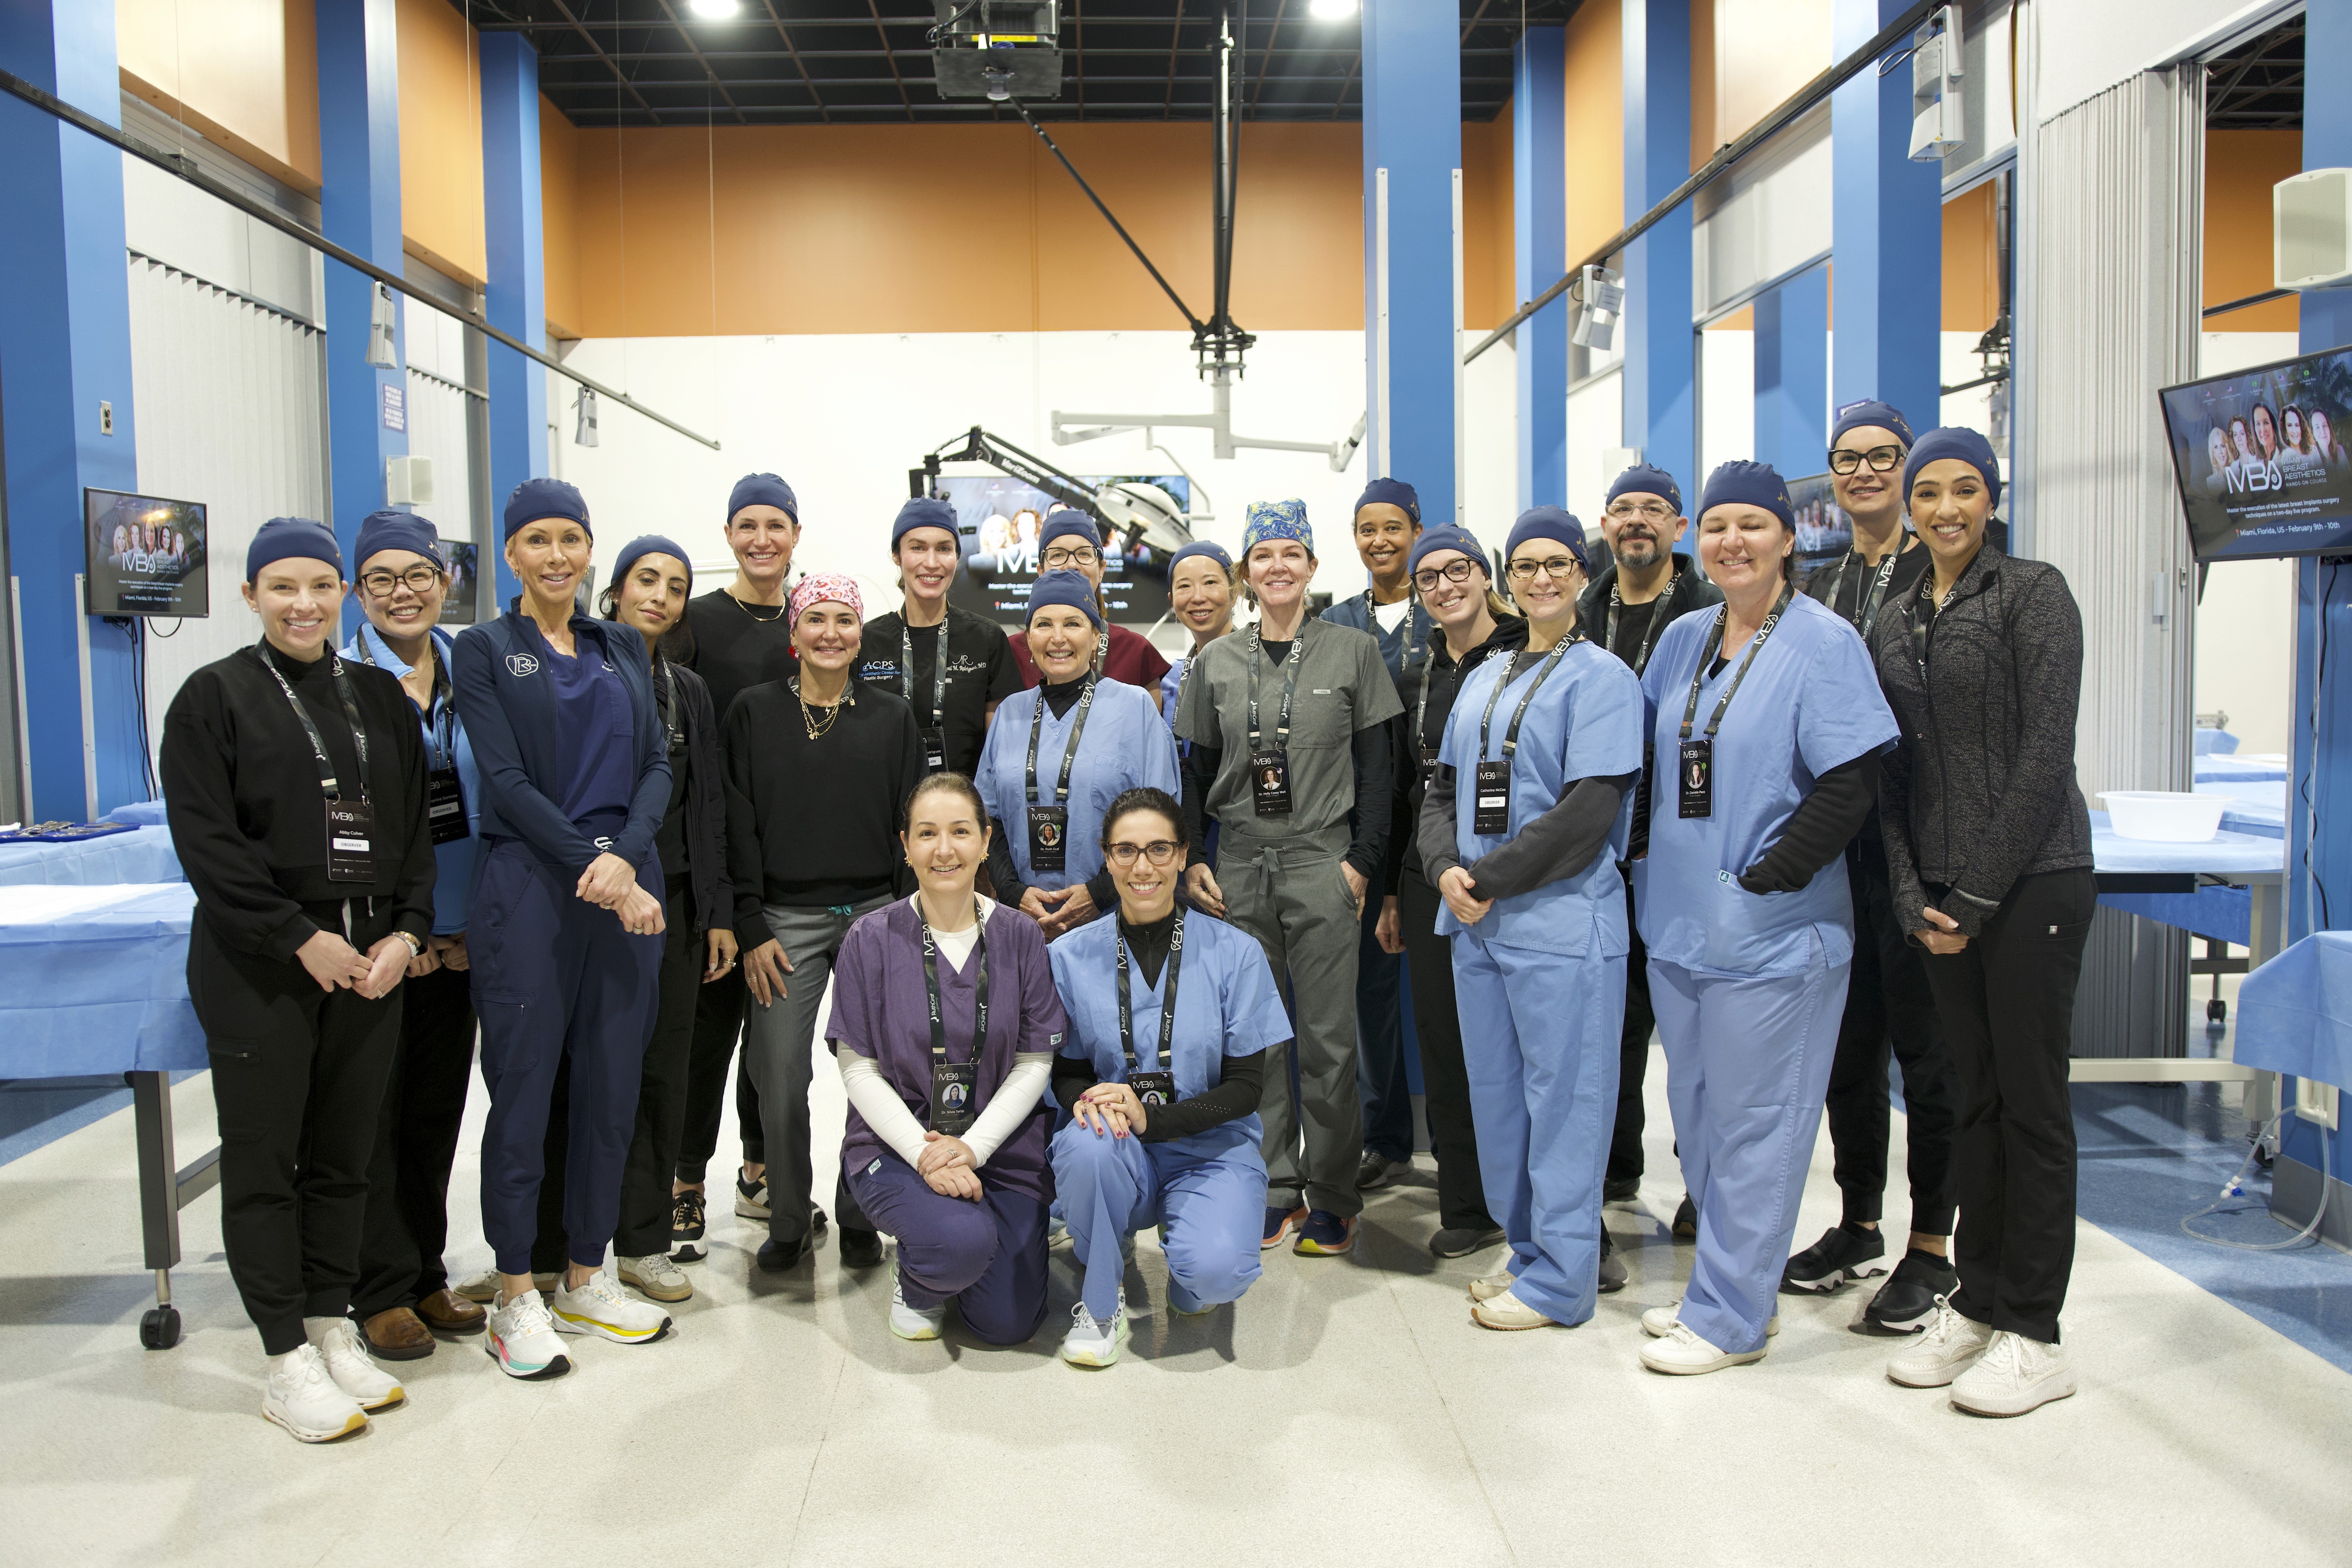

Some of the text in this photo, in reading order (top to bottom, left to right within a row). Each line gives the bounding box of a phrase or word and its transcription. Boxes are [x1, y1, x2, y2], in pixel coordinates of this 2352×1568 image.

[1001, 458, 1040, 484] VariZoom
[2225, 460, 2282, 494] MBA
[2283, 463, 2309, 473] BREAST
[2285, 469, 2326, 480] AESTHETICS
[122, 552, 156, 574] MBA
[1877, 556, 1897, 587] MBA
[1249, 627, 1260, 652] MBA
[1753, 614, 1779, 645] MBA
[1098, 633, 1109, 656] MBA
[1290, 638, 1303, 663] MBA
[1551, 633, 1575, 656] MBA
[863, 660, 895, 670] ACPS
[1180, 656, 1191, 681] MBA
[1502, 650, 1519, 675] MBA
[1080, 682, 1095, 707] MBA
[1513, 705, 1524, 726] RuthGraf
[1253, 757, 1272, 766] MBA
[1683, 750, 1699, 759] MBA
[430, 781, 441, 790] BA
[1480, 771, 1496, 780] MBA
[332, 811, 354, 822] MBA
[922, 923, 936, 956] MBA
[1170, 918, 1184, 951] MBA
[939, 1072, 959, 1081] MBA
[1133, 1080, 1154, 1089] MBA
